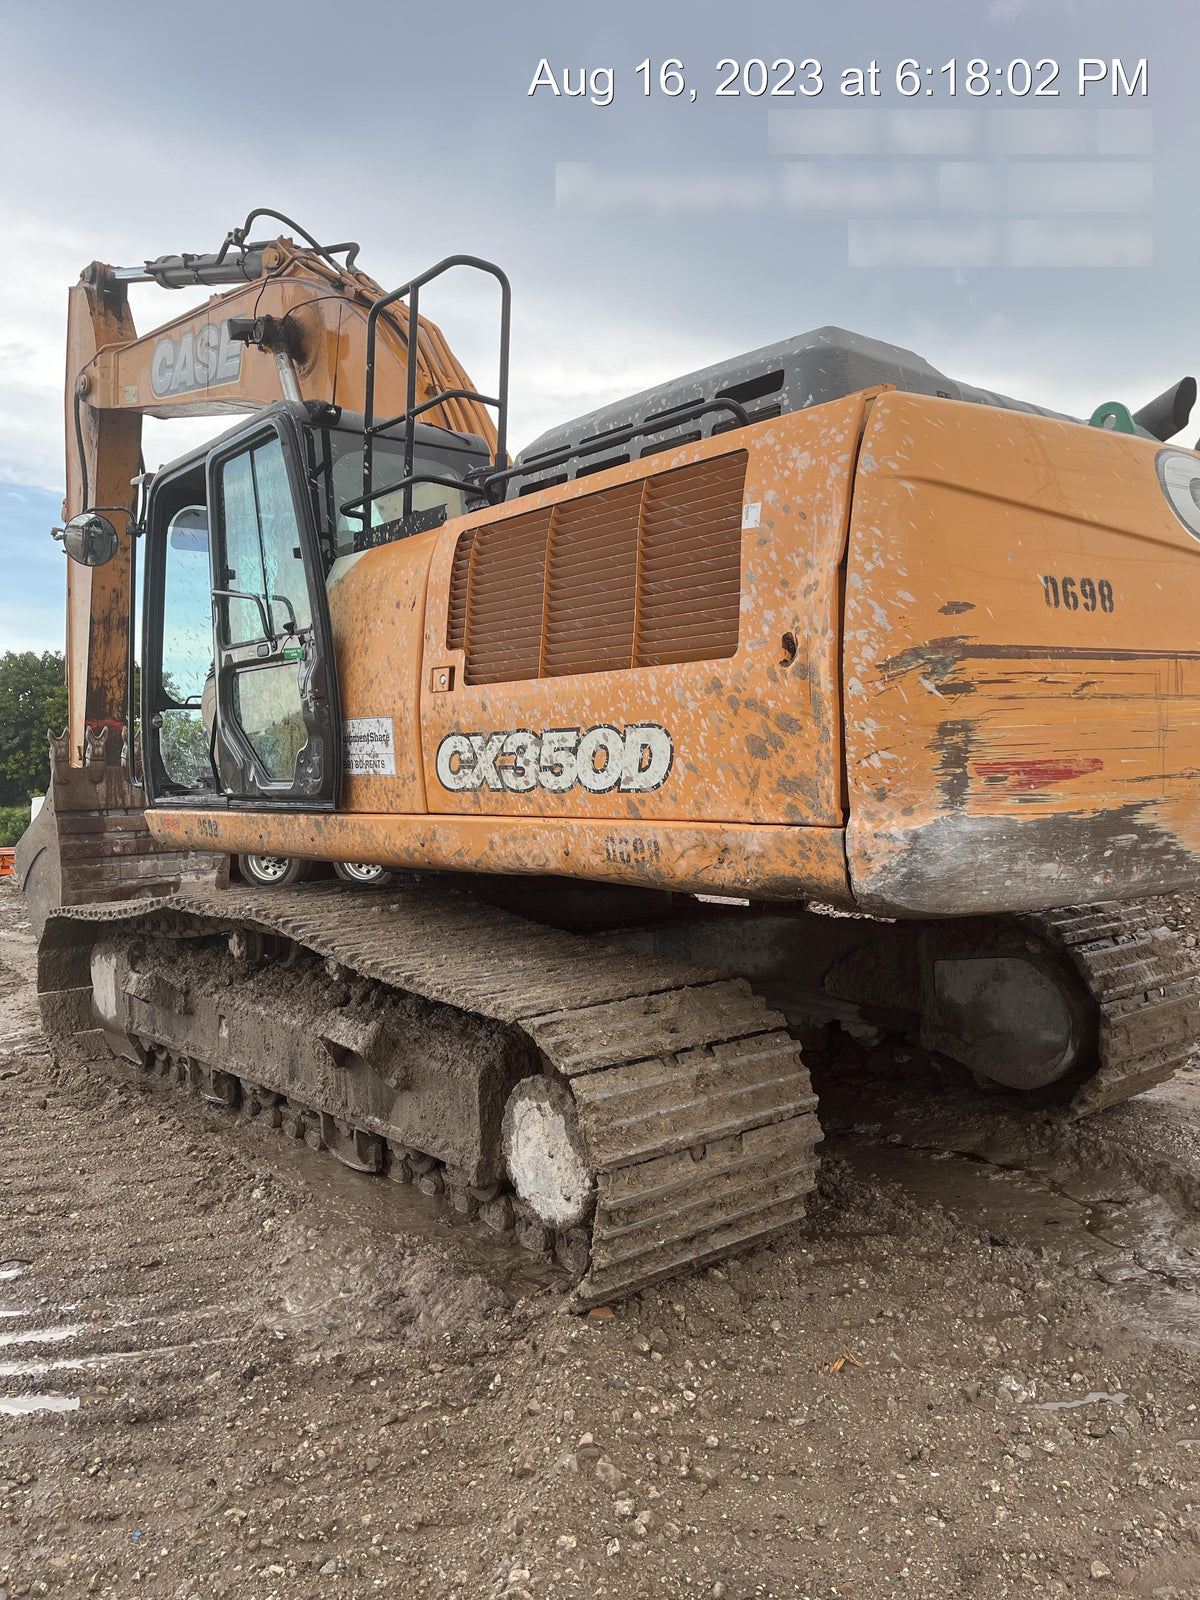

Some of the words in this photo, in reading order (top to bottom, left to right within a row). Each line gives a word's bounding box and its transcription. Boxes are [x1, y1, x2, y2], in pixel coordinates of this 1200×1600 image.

[151, 314, 246, 394] CASE
[342, 731, 390, 745] uipmentShare
[435, 723, 674, 794] CX350D
